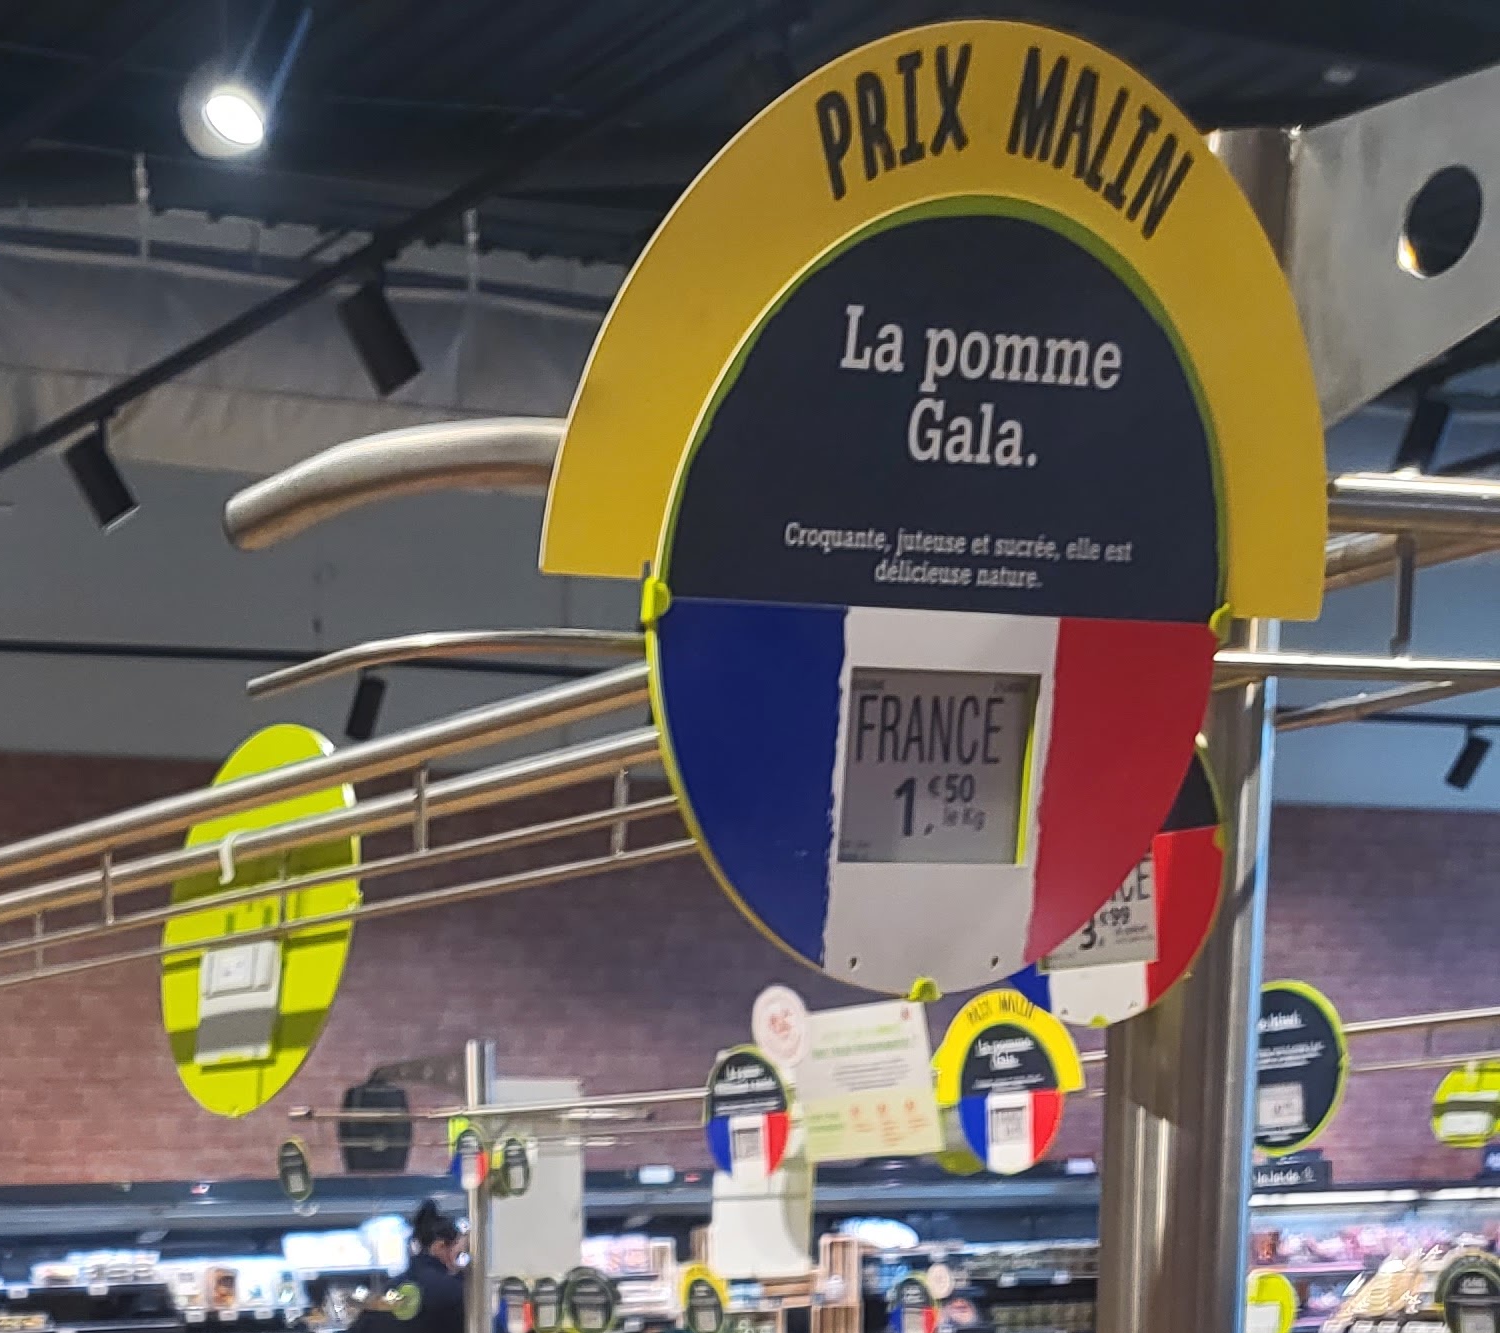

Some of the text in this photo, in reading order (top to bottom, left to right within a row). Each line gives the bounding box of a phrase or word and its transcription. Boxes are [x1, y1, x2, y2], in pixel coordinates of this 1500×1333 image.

[816, 43, 1195, 240] PRIX MALIN
[839, 304, 1123, 393] La pomme
[907, 397, 1039, 468] Gala.
[784, 521, 1133, 562] Croquante, juteuse et sucrée, elle est
[874, 557, 1044, 588] délicieuse nature.
[854, 693, 1005, 766] FRANCE
